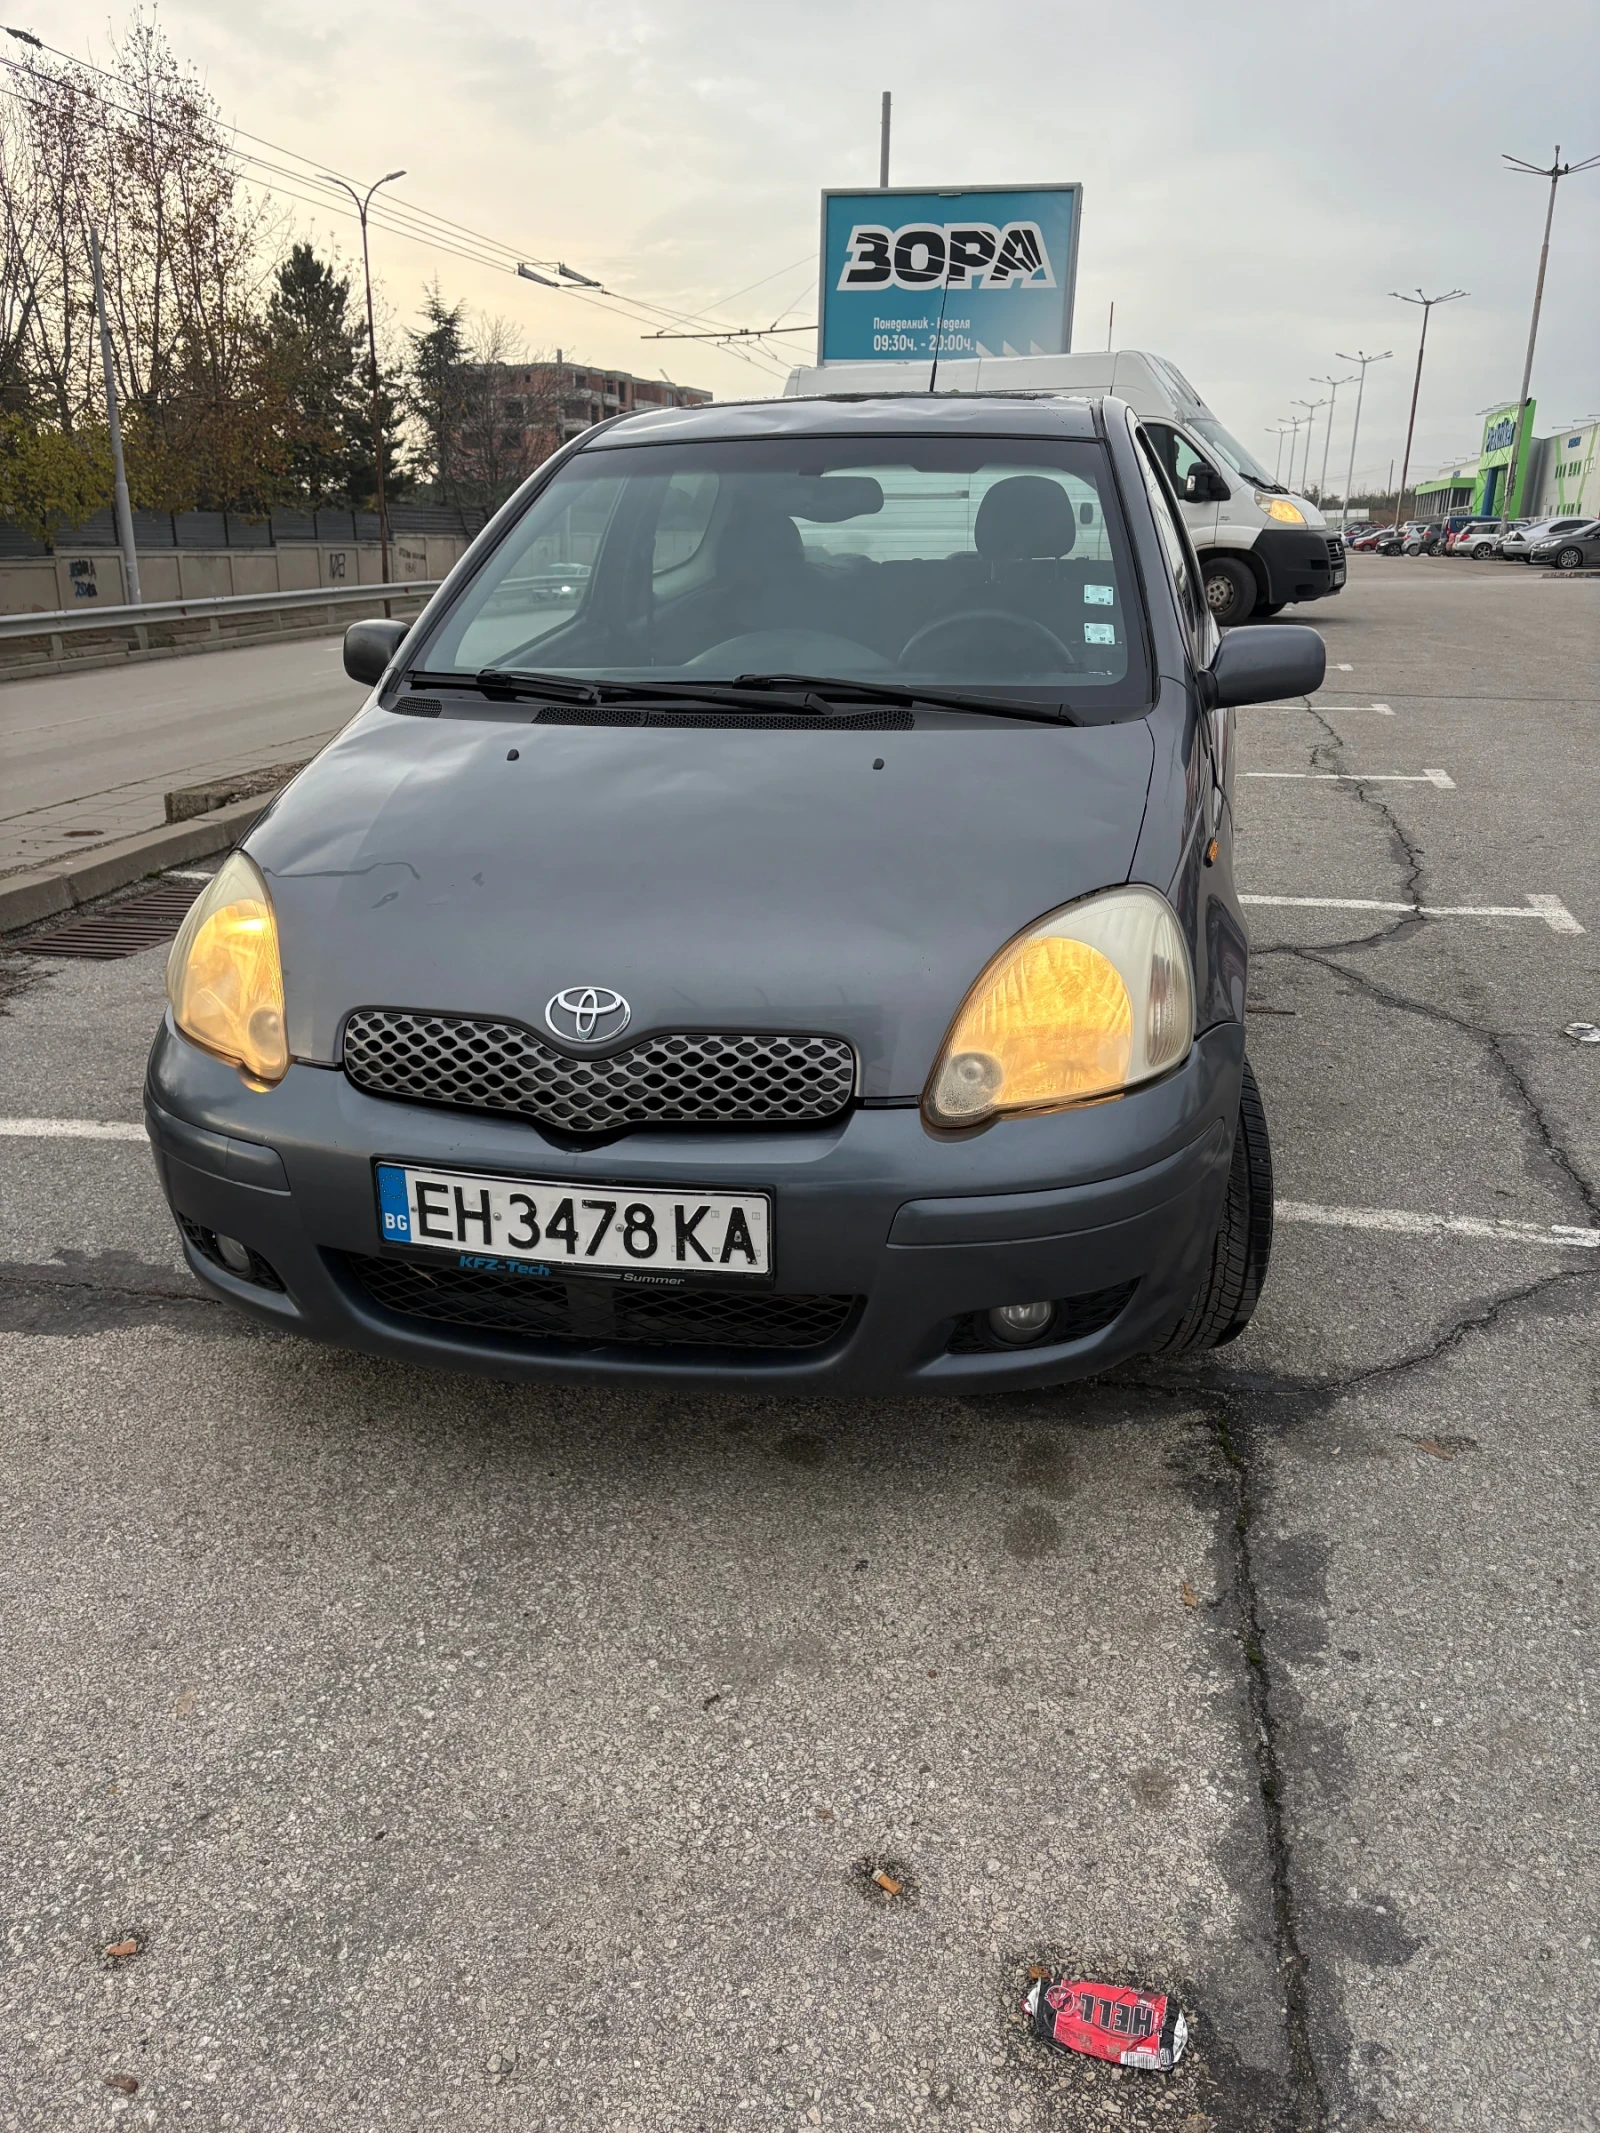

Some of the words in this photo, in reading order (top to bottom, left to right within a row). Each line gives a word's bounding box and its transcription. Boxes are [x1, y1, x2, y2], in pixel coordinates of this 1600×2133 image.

[837, 221, 1057, 290] ЗОРА
[873, 316, 928, 332] Понеделник
[873, 334, 918, 351] 09:30ч.
[928, 334, 975, 351] 20:00ч.
[384, 1211, 408, 1232] BG
[415, 1179, 493, 1246] EH
[507, 1192, 659, 1261] 3478
[674, 1203, 759, 1265] KA
[459, 1256, 550, 1276] KFZ-Tech
[623, 1273, 685, 1287] Summer
[1080, 1993, 1153, 2037] HELL
